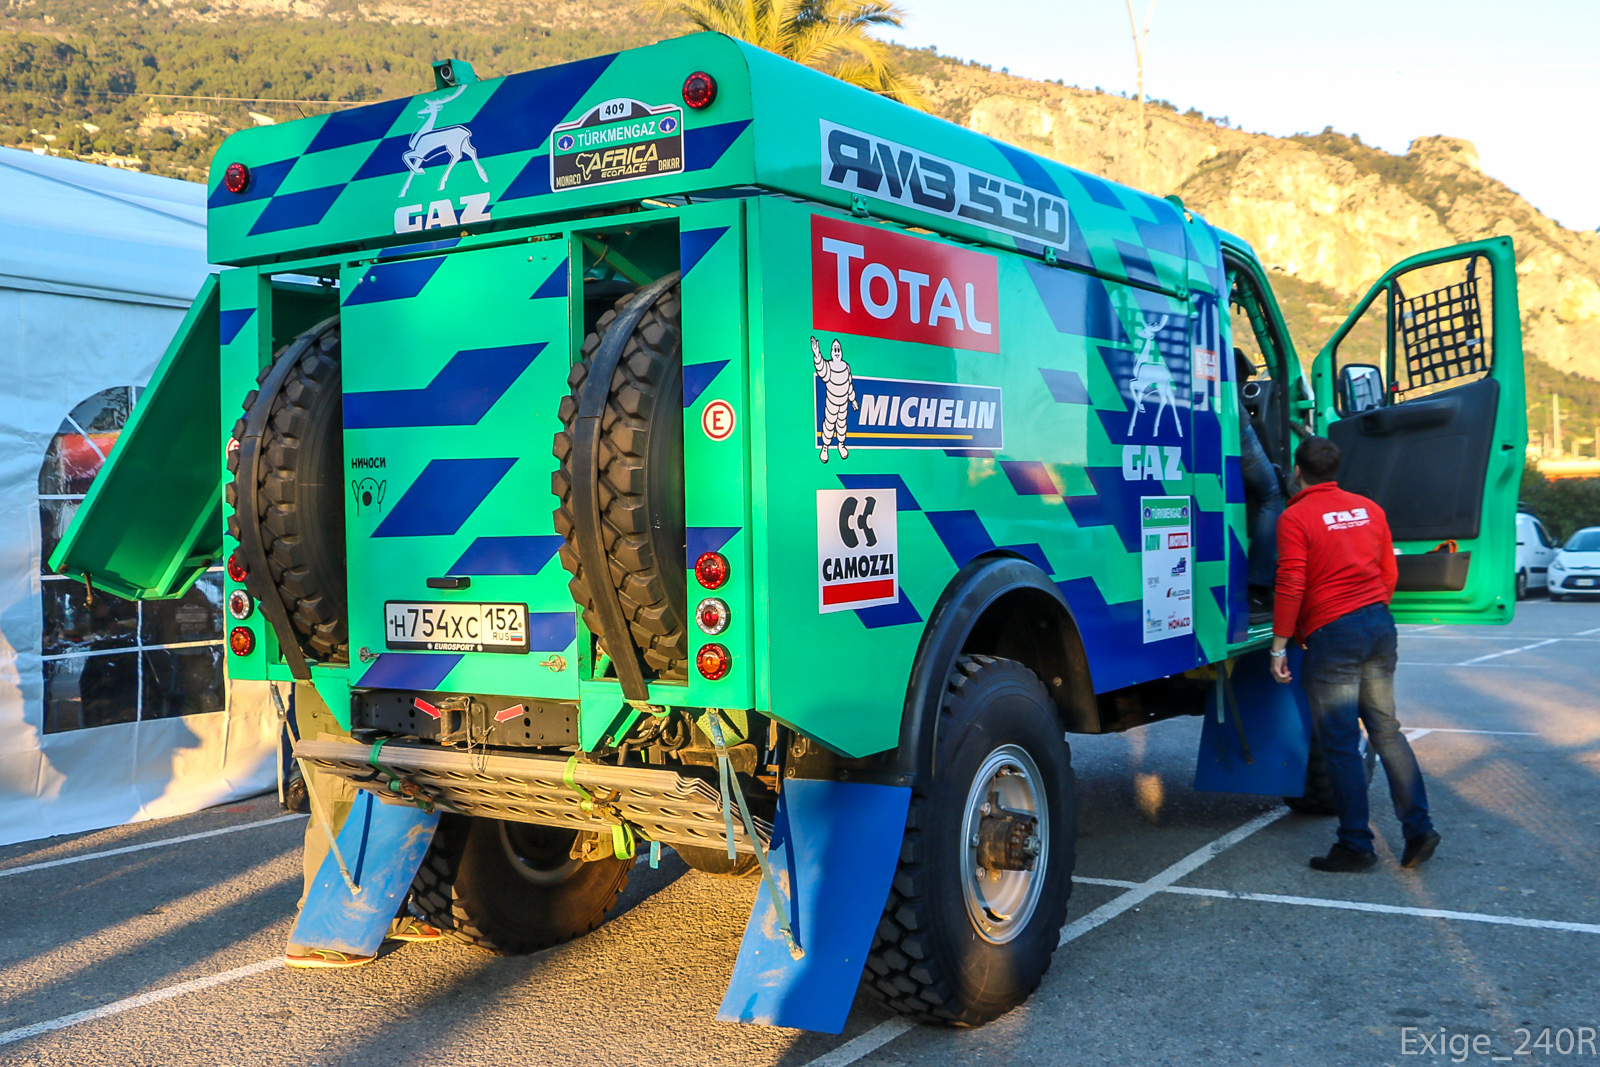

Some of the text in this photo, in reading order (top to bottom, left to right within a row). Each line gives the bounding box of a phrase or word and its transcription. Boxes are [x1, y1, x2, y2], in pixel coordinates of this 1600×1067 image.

[605, 102, 624, 116] 409
[577, 121, 656, 147] TÜRKMENGAZ
[585, 143, 658, 175] AFRICA
[658, 157, 680, 171] DAKAR
[556, 173, 581, 188] MONACO
[394, 192, 491, 234] GAZ
[957, 172, 1067, 245] 530
[713, 410, 724, 430] E
[858, 394, 996, 429] MICHELIN
[351, 457, 386, 469] НИЧОСИ
[1122, 444, 1182, 481] GAZ
[1322, 507, 1370, 525] ГАЗ
[822, 553, 894, 582] CAMOZZI
[485, 608, 518, 631] 152
[493, 632, 510, 641] RUS
[434, 643, 475, 652] EUROSPORT
